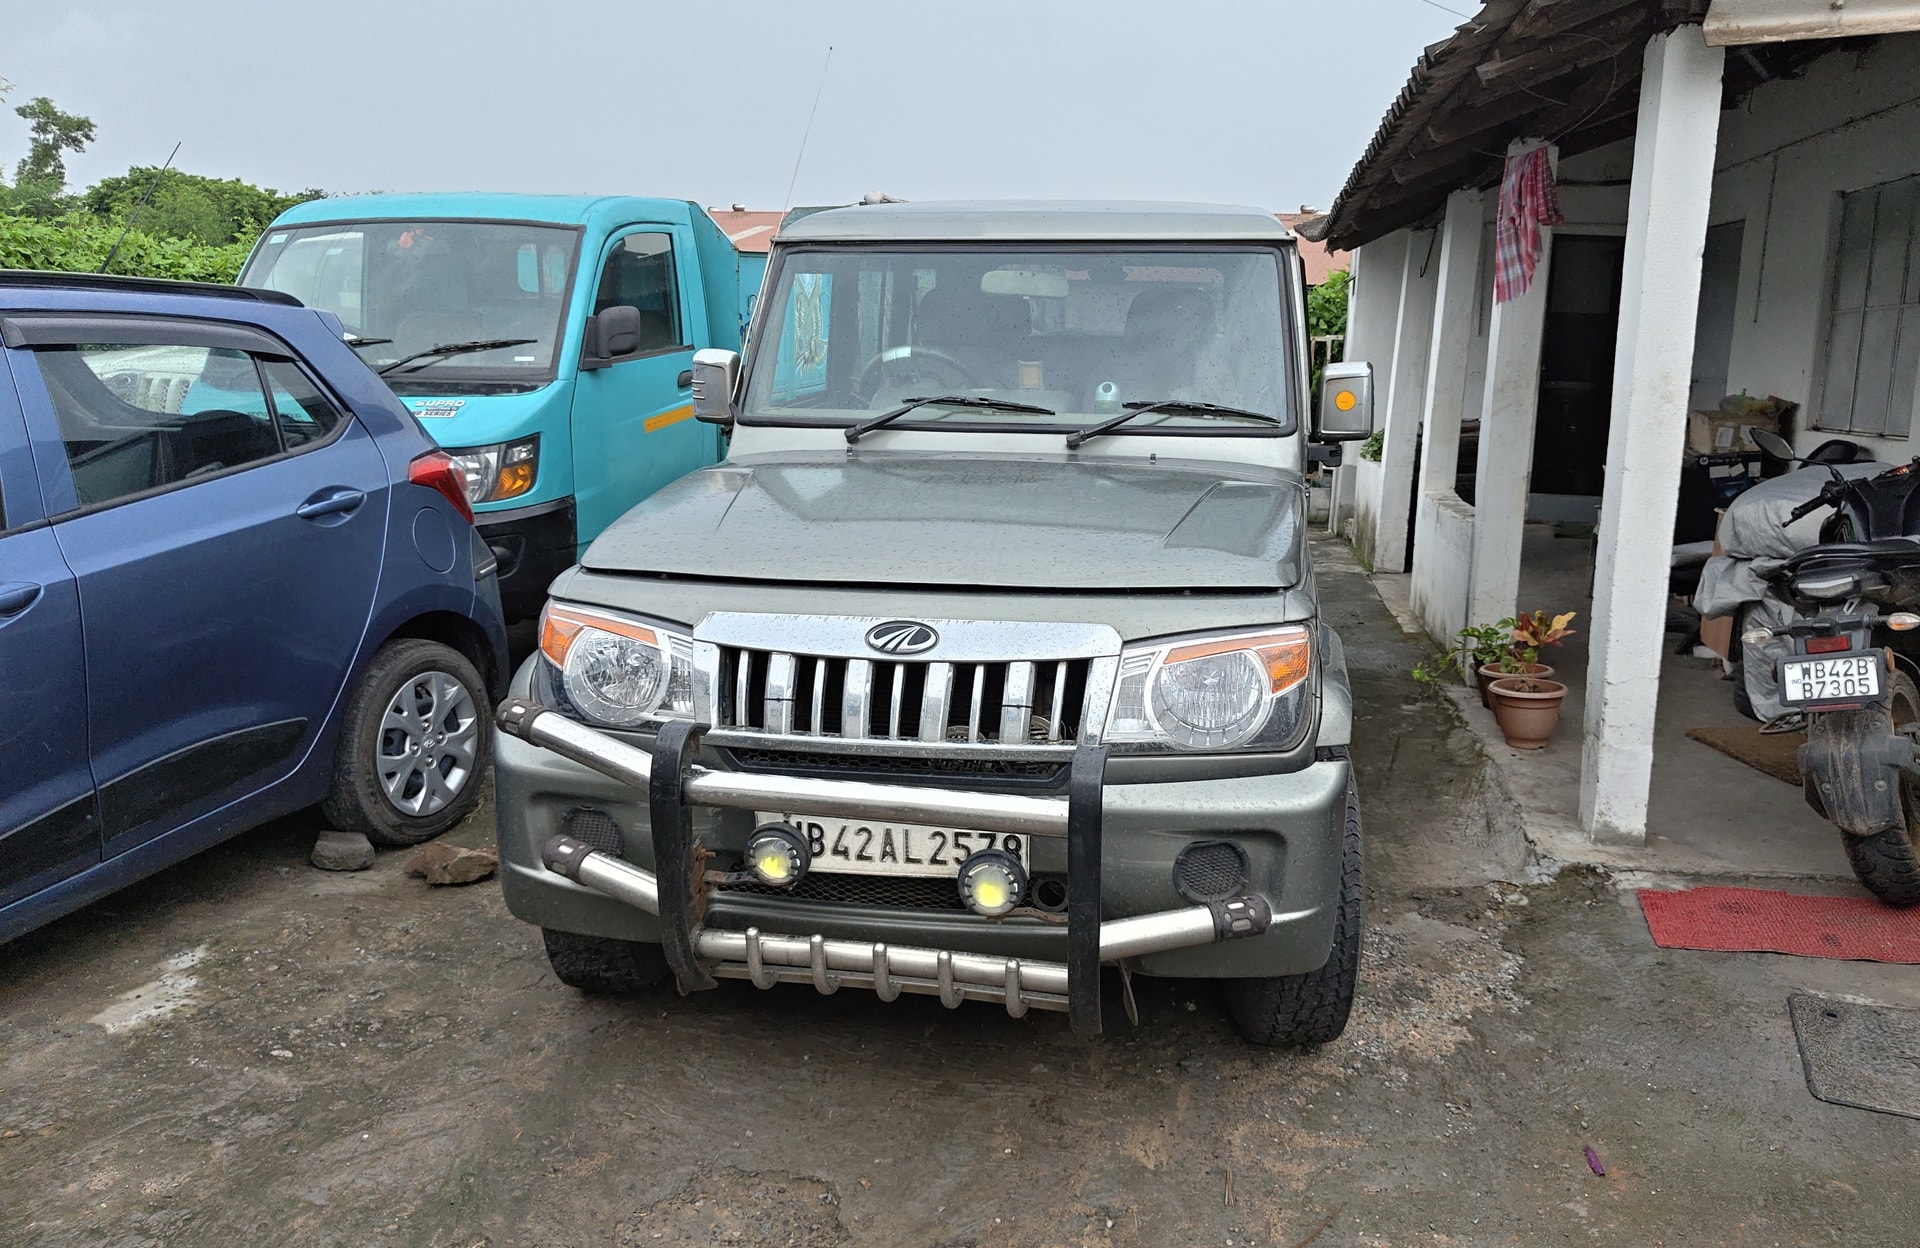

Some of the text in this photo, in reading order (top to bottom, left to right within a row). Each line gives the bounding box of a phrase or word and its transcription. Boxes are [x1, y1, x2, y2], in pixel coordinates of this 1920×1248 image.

[1800, 658, 1869, 681] WB42B
[1802, 677, 1871, 699] B7305
[783, 818, 1022, 866] B42AL2578
